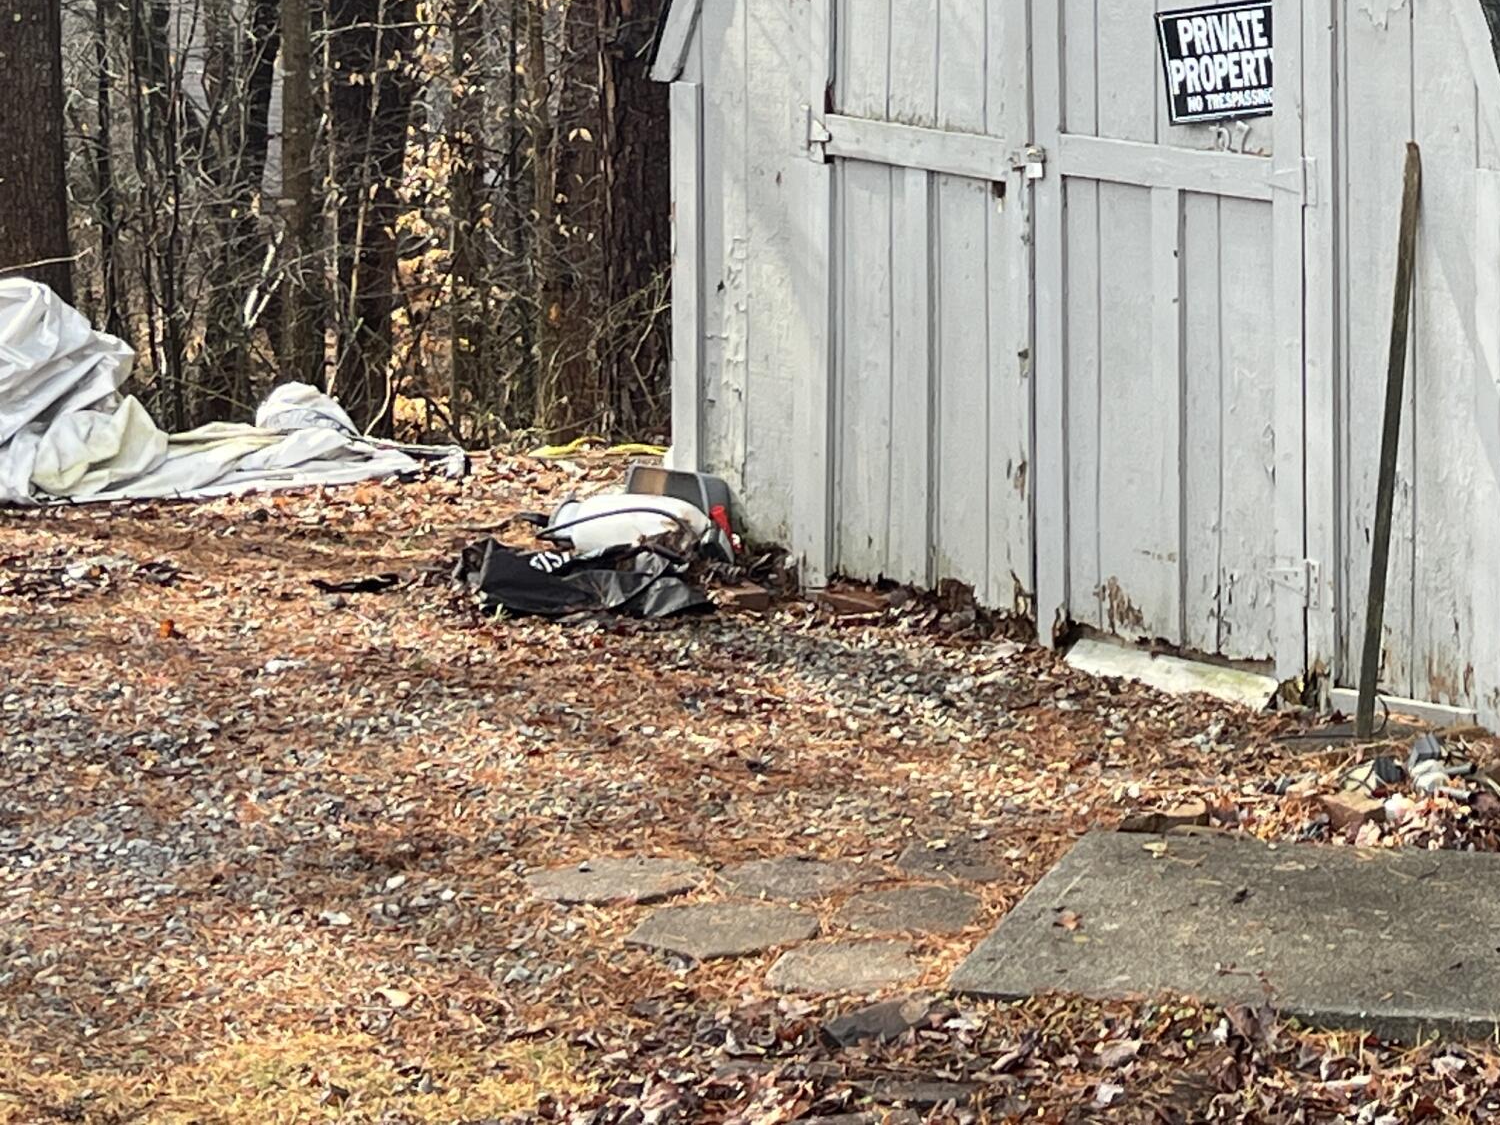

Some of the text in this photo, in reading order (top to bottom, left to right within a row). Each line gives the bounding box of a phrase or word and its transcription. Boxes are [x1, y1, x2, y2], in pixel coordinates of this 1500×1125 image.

[1176, 8, 1268, 57] PRIVATE
[1169, 47, 1273, 95] PROPERT
[1186, 95, 1204, 113] NO
